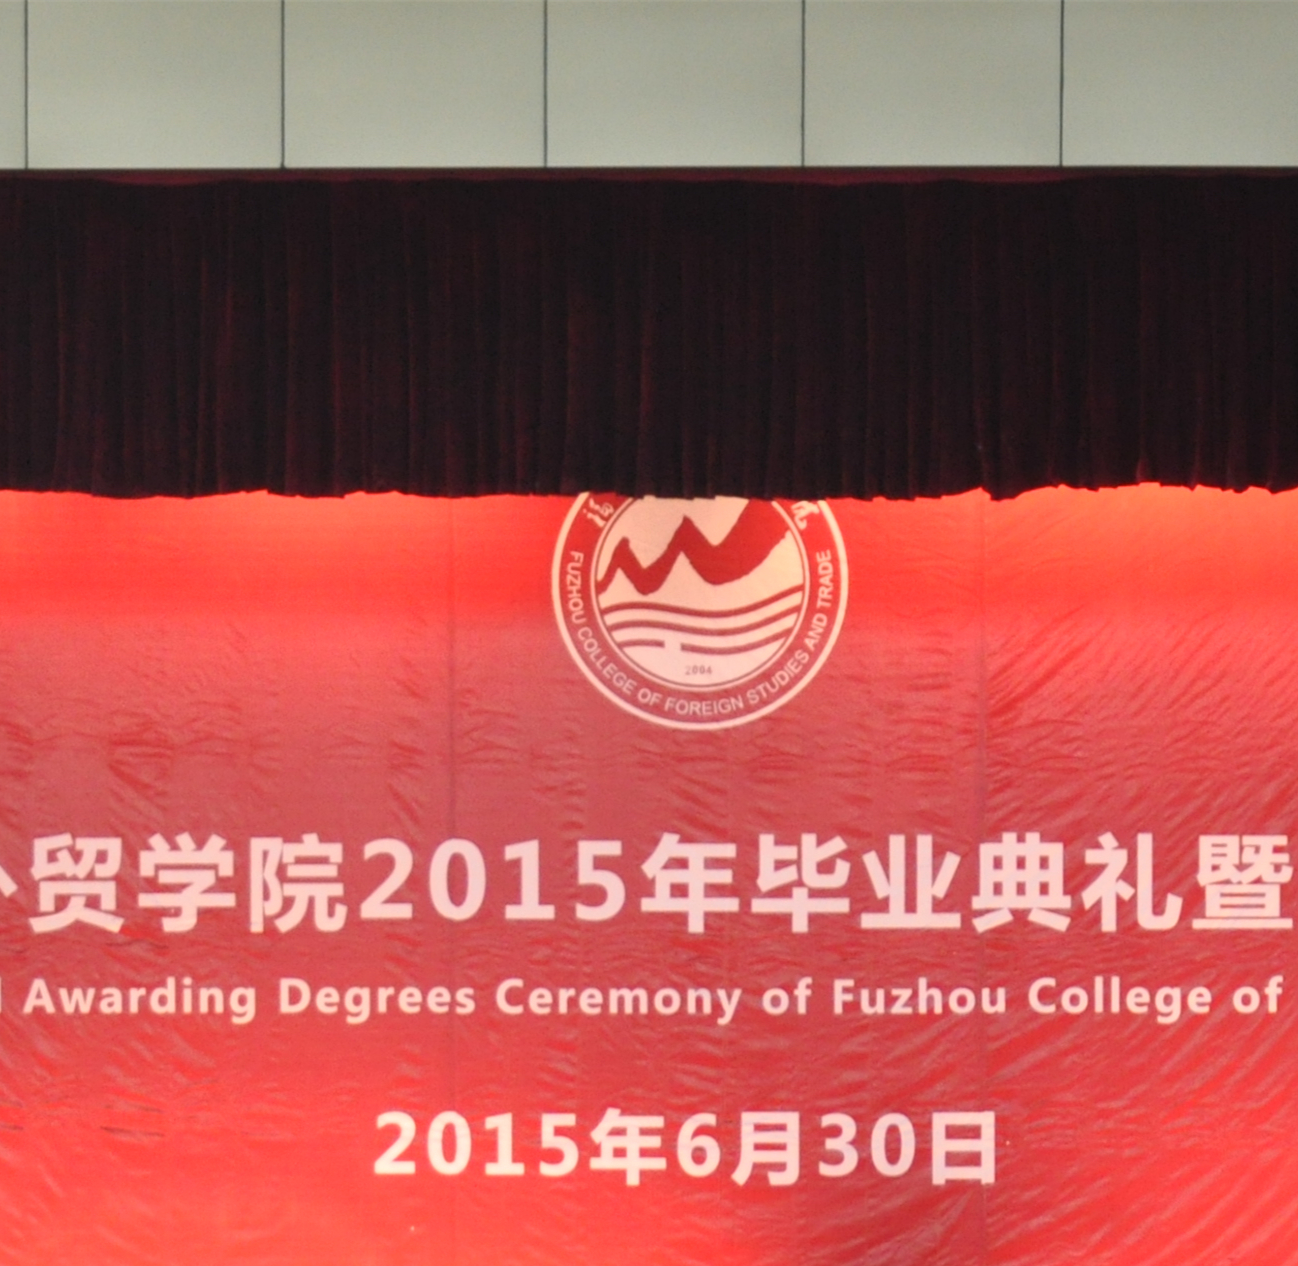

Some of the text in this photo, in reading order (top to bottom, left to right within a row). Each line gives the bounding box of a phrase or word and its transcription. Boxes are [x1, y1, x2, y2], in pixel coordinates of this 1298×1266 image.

[566, 549, 834, 717] FUZHOU COLLEGE OF FOREIGN STUDIES AND TRADE
[21, 976, 257, 1025] Awarding
[278, 977, 476, 1025] Degrees
[495, 977, 745, 1026] Ceremony
[760, 976, 813, 1016] of
[832, 976, 1008, 1016] Fuzhou
[1027, 975, 1214, 1025] College
[1231, 974, 1285, 1014] of
[372, 1107, 997, 1187] 2015年6月30日
